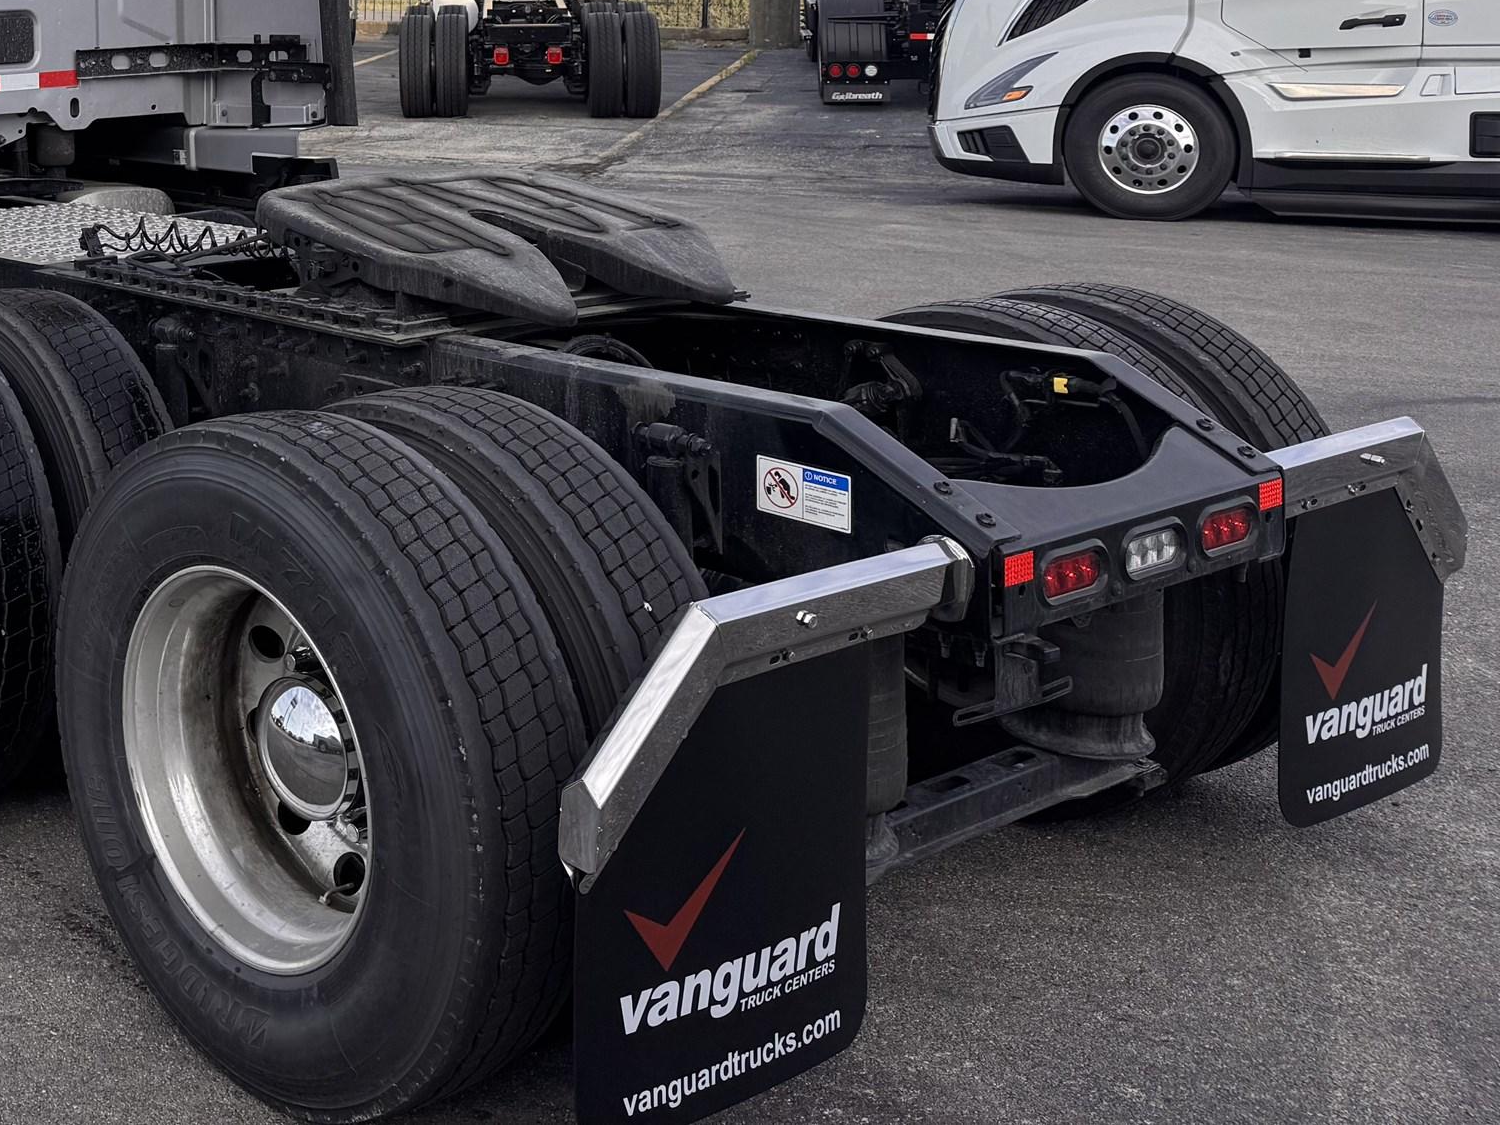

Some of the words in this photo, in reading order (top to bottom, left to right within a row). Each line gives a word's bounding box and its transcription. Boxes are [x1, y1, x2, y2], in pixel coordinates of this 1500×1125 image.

[814, 475, 837, 485] NOTICE
[1305, 663, 1428, 744] vanguard
[1371, 719, 1395, 736] TRUCK
[1396, 706, 1425, 727] CENTERS
[1306, 742, 1429, 804] vanguardtrucks.com
[619, 902, 841, 1035] vanguard
[739, 983, 781, 1012] TRUCK
[784, 959, 836, 994] CENTERS
[622, 1008, 841, 1117] vanguardtrucks.com
